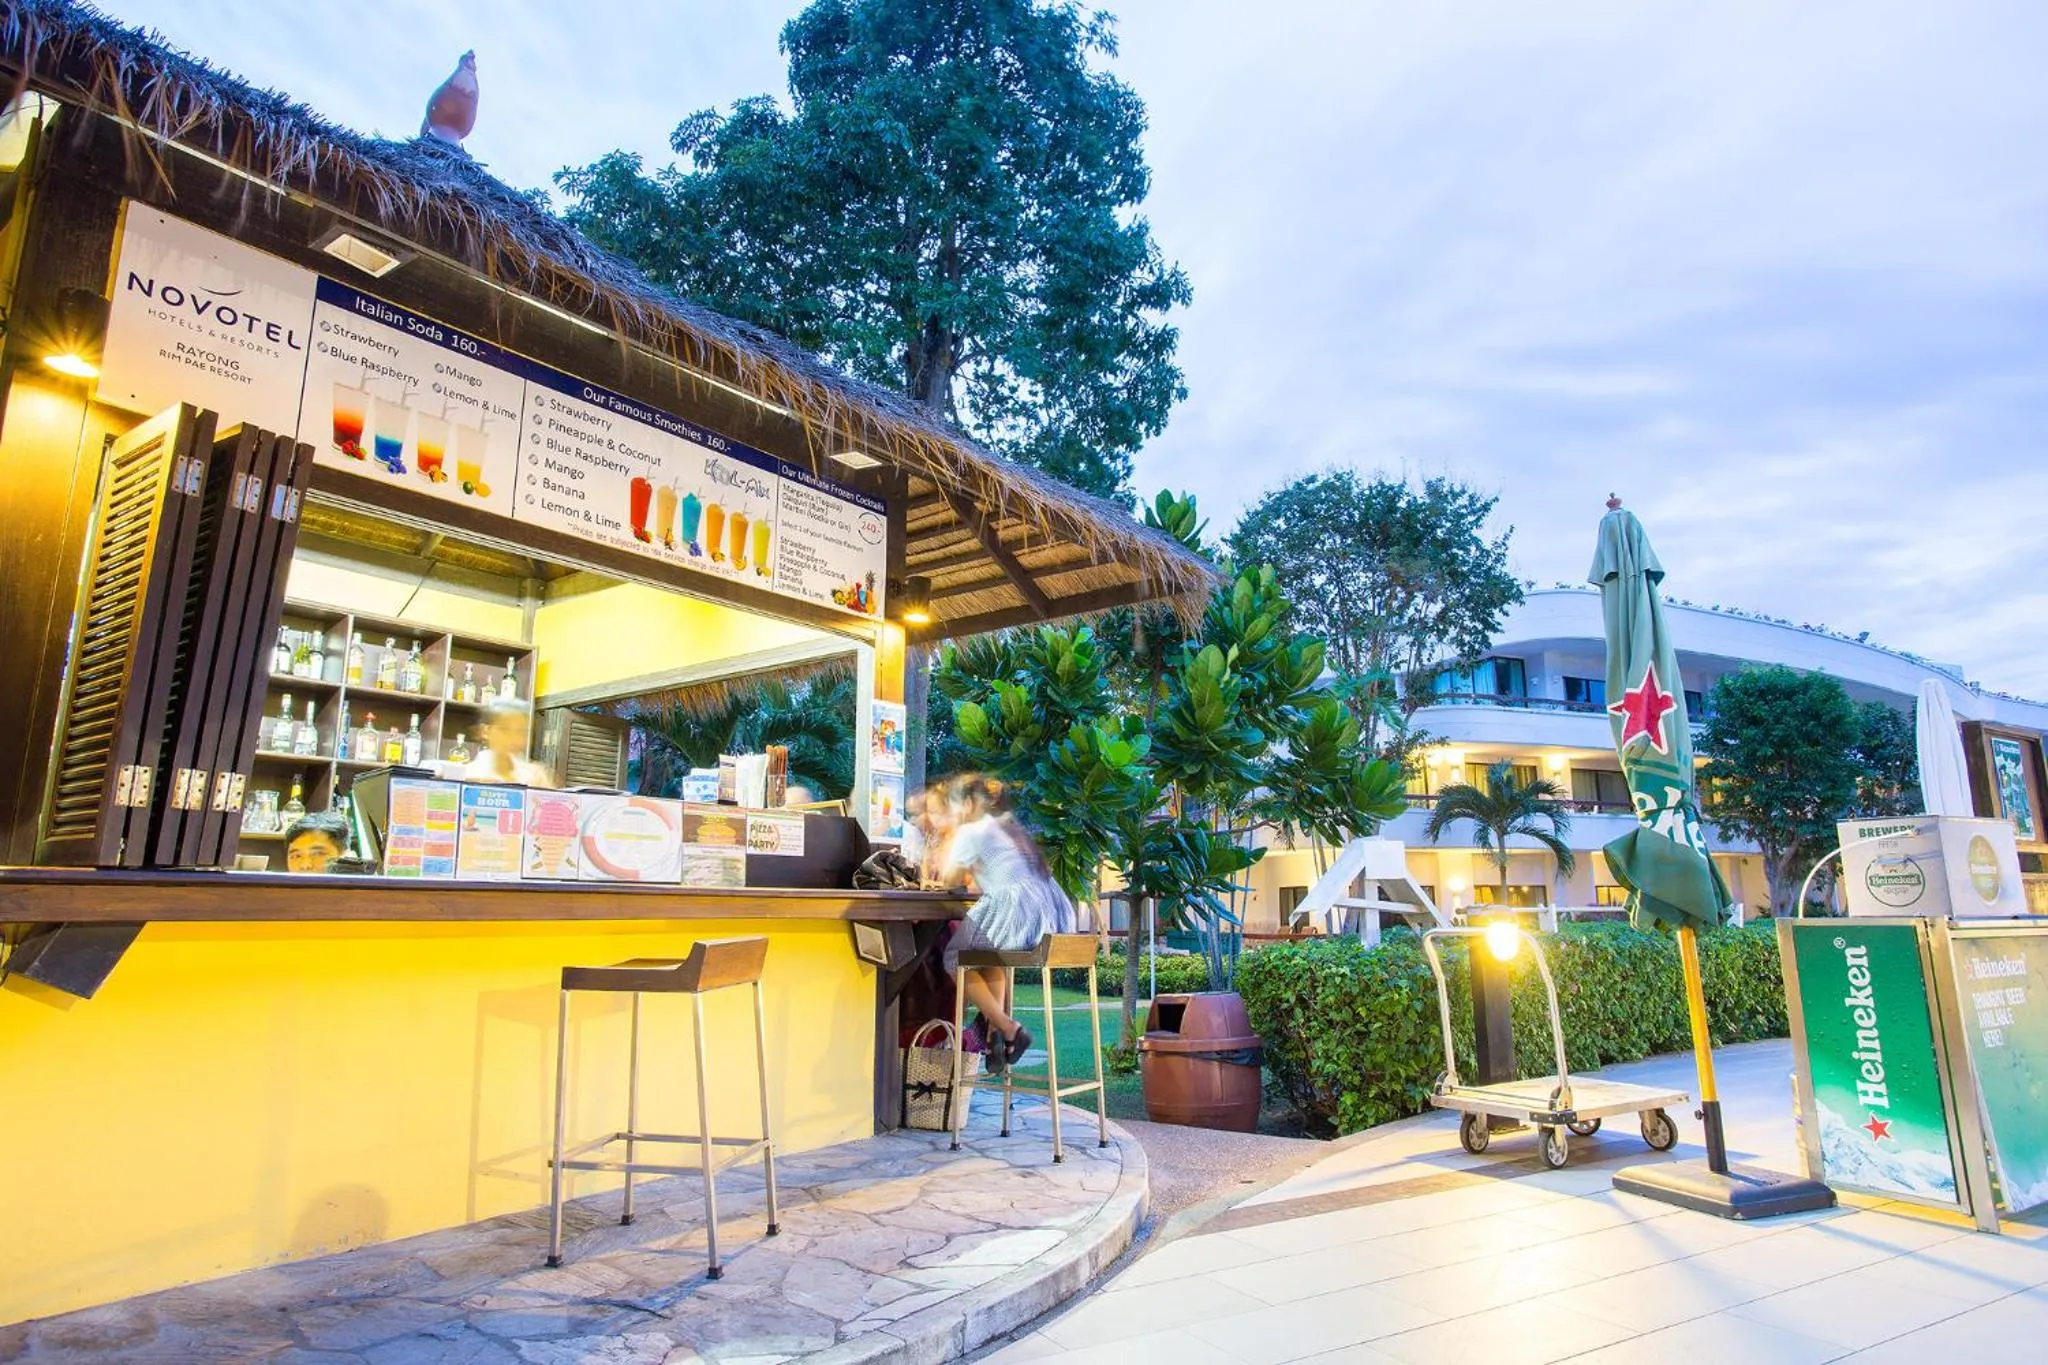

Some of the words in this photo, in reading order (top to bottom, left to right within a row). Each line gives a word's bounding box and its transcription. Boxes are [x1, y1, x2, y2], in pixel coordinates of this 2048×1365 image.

[127, 271, 301, 350] NOVOTEL
[354, 295, 404, 327] Italian
[406, 316, 444, 343] Soda
[450, 333, 487, 357] 160.-
[148, 307, 203, 333] HOTELS
[208, 329, 217, 338] &
[220, 332, 280, 359] RESORTS
[332, 323, 401, 359] Strawberry
[159, 348, 182, 365] RIM
[209, 364, 254, 385] RESORT
[176, 341, 241, 371] RAYONG
[329, 345, 358, 365] Blue
[360, 356, 421, 388] Raspberry
[444, 364, 484, 388] Mango
[442, 385, 480, 408] Lemon
[481, 400, 491, 412] &
[493, 405, 518, 422] Lime
[549, 398, 613, 432] Strawberry
[583, 386, 606, 404] Our
[608, 396, 653, 422] Famous
[654, 414, 703, 442] Smothies
[706, 434, 732, 452] 160.-
[546, 437, 572, 456] Blue
[574, 446, 631, 477] Raspberry
[548, 418, 605, 447] Pineapple
[606, 439, 616, 452] &
[618, 443, 662, 467] Coconut
[543, 457, 585, 480] Mango
[542, 477, 586, 501] Banana
[781, 464, 796, 478] Our
[798, 470, 830, 491] Ultimate
[830, 483, 855, 500] Frozen
[855, 494, 885, 512] Cocktails
[540, 497, 580, 519] Lemon
[583, 509, 592, 523] &
[595, 513, 622, 532] Lime
[748, 840, 776, 849] PARTY
[750, 823, 774, 834] PIZZA
[1844, 944, 1890, 1110] Heineken
